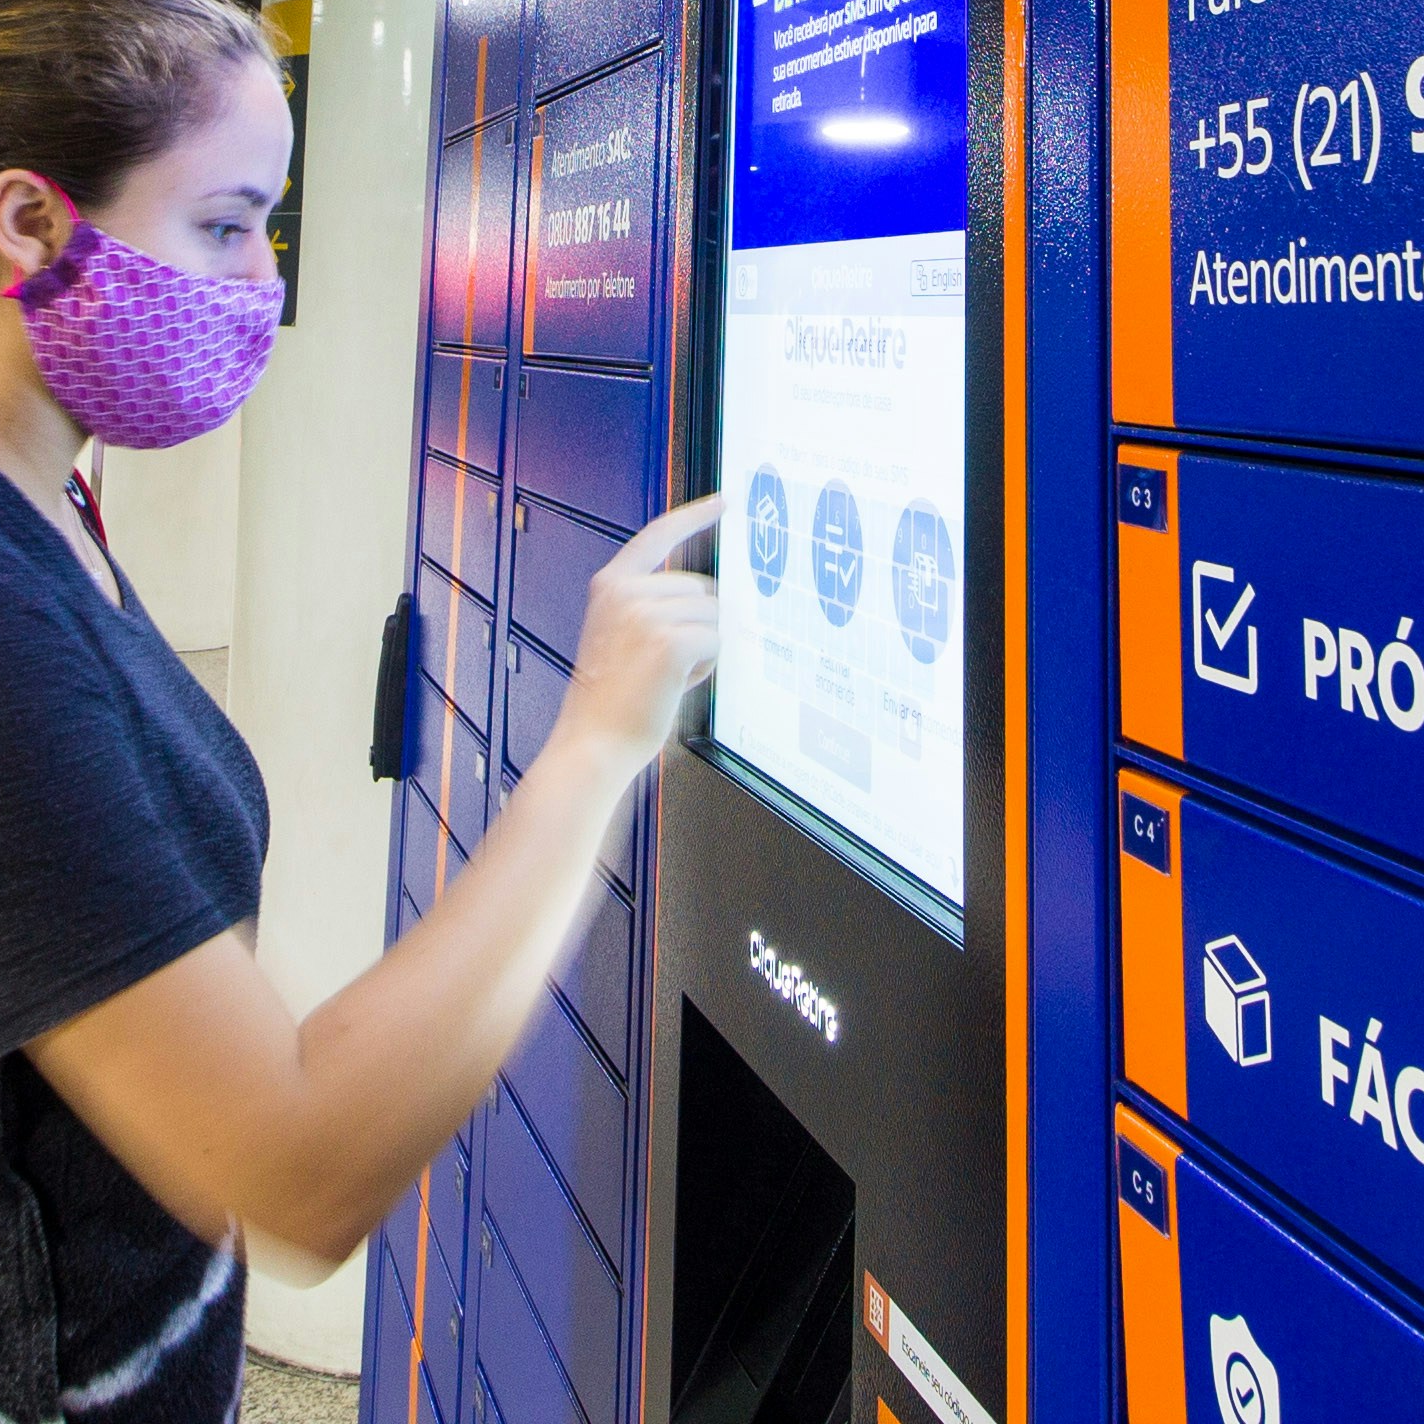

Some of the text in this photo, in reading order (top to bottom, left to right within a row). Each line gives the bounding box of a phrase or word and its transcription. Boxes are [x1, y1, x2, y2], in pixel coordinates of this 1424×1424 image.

[773, 10, 938, 82] sua encomenda estiver disponível para
[774, 24, 793, 51] Você
[793, 10, 828, 44] receberá
[828, 10, 845, 37] por
[1188, 95, 1274, 179] +55
[1292, 71, 1381, 190] (21)
[551, 140, 605, 178] Atendimento
[548, 197, 631, 248] 0800 887 16 44
[545, 268, 635, 305] Atendimento por Telefone
[931, 268, 962, 292] English
[931, 1375, 944, 1398] seu
